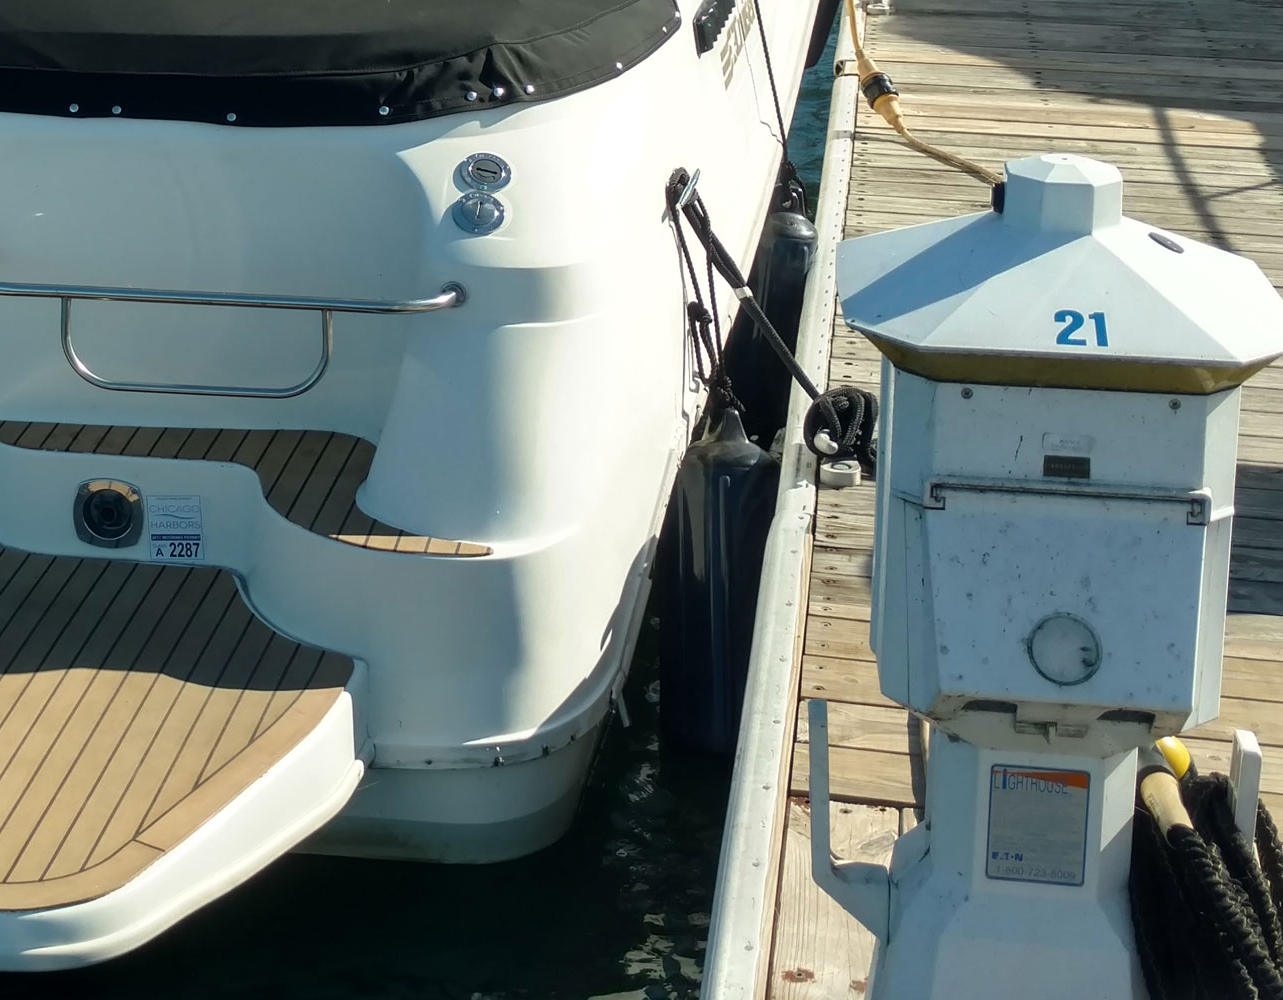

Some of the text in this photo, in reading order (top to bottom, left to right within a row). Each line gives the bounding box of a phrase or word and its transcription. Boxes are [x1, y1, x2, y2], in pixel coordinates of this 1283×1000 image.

[1053, 309, 1110, 348] 21
[149, 505, 199, 513] CHICAGO
[150, 521, 201, 529] HARBORS
[155, 542, 200, 558] A 2287
[993, 769, 1069, 795] LIGHTHOUSE
